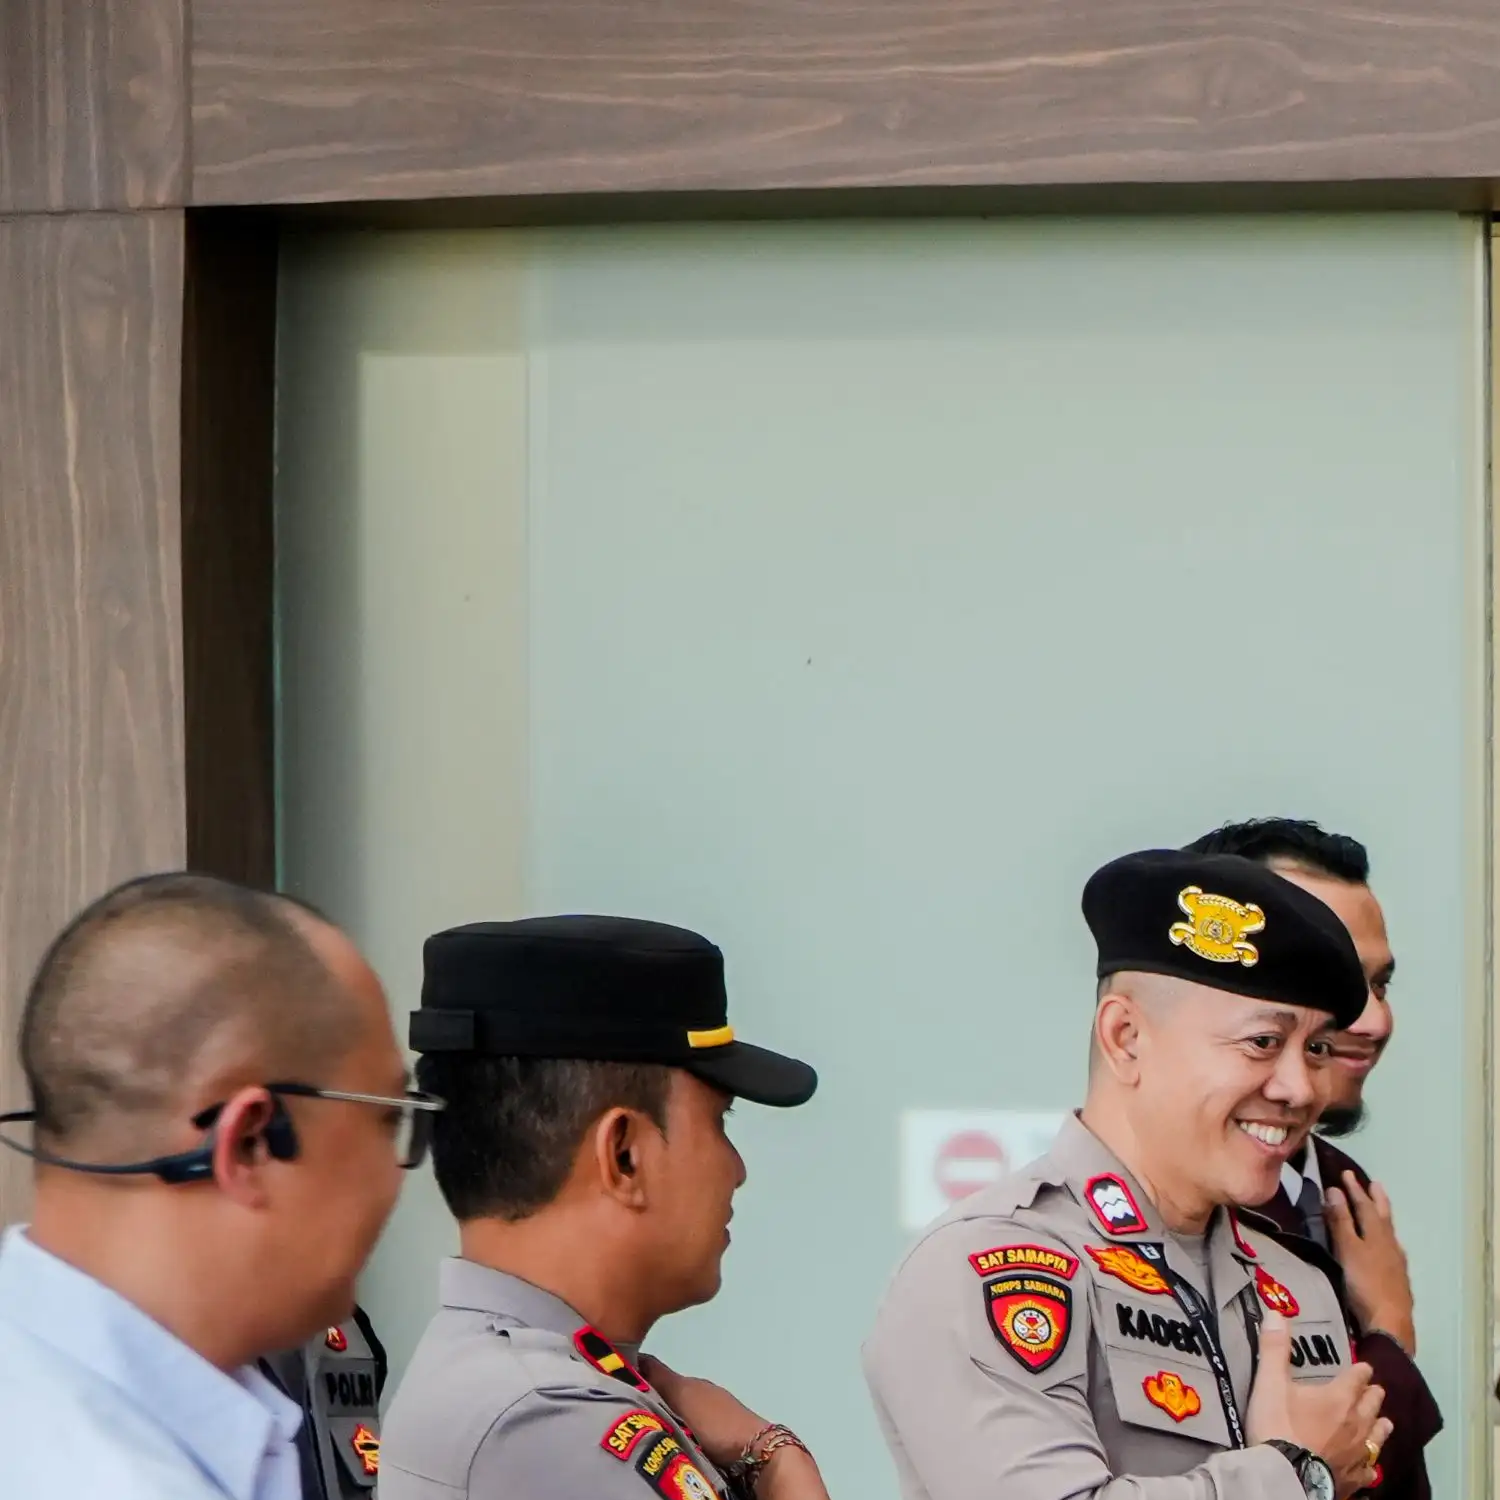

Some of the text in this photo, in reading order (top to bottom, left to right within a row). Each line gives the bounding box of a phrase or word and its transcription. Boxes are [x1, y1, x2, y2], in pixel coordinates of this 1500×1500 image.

[977, 1248, 1068, 1273] SAT SAMAPTA
[1290, 1333, 1341, 1368] OLRI
[608, 1421, 636, 1452] SAT
